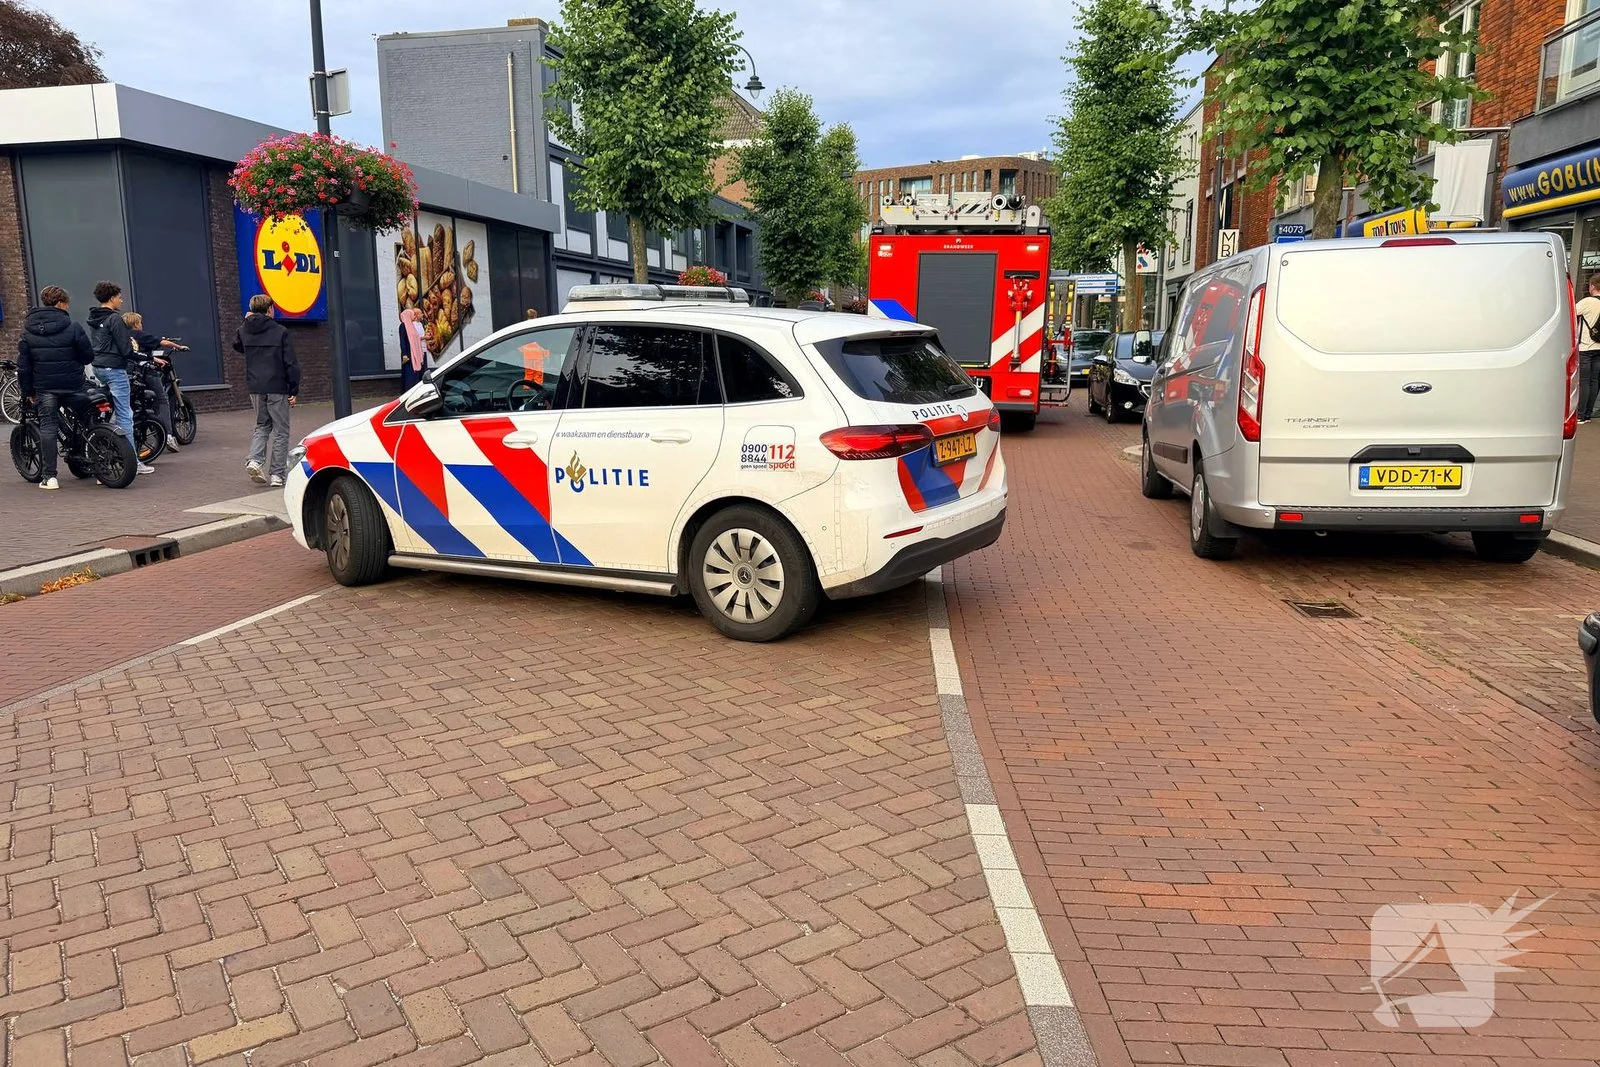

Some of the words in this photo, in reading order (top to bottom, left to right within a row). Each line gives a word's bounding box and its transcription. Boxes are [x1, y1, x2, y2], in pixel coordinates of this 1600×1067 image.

[911, 404, 955, 420] POLITIE
[561, 430, 596, 438] waakzaam
[606, 430, 644, 438] dienstbaar
[741, 444, 767, 453] 0900
[769, 444, 795, 460] 112
[741, 454, 767, 463] 8844
[768, 460, 795, 471] spoed
[555, 467, 649, 493] POLITIE
[1377, 468, 1453, 483] VDD-71-K
